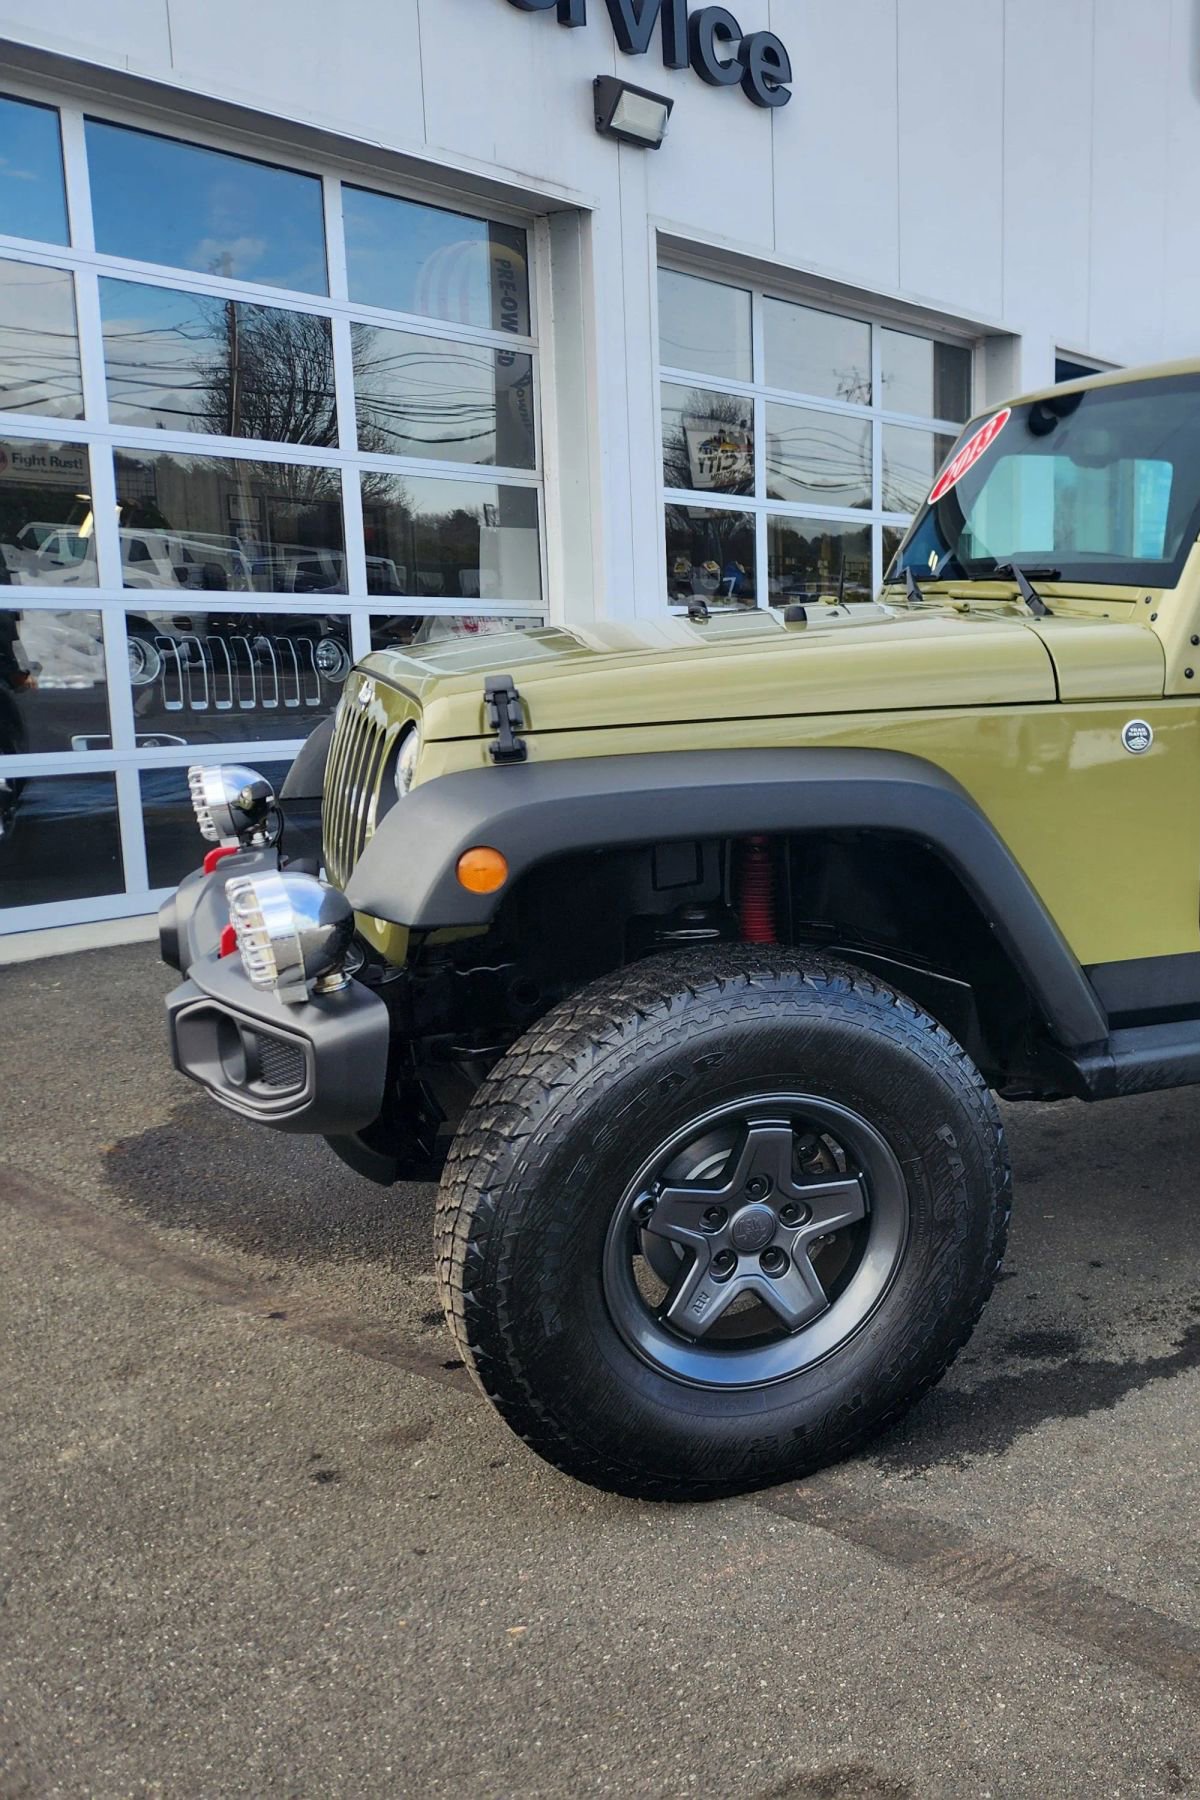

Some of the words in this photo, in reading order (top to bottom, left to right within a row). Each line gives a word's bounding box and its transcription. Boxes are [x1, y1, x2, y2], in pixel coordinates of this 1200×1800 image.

[507, 0, 793, 108] vice
[11, 452, 46, 467] Fight
[49, 455, 83, 470] Rust!
